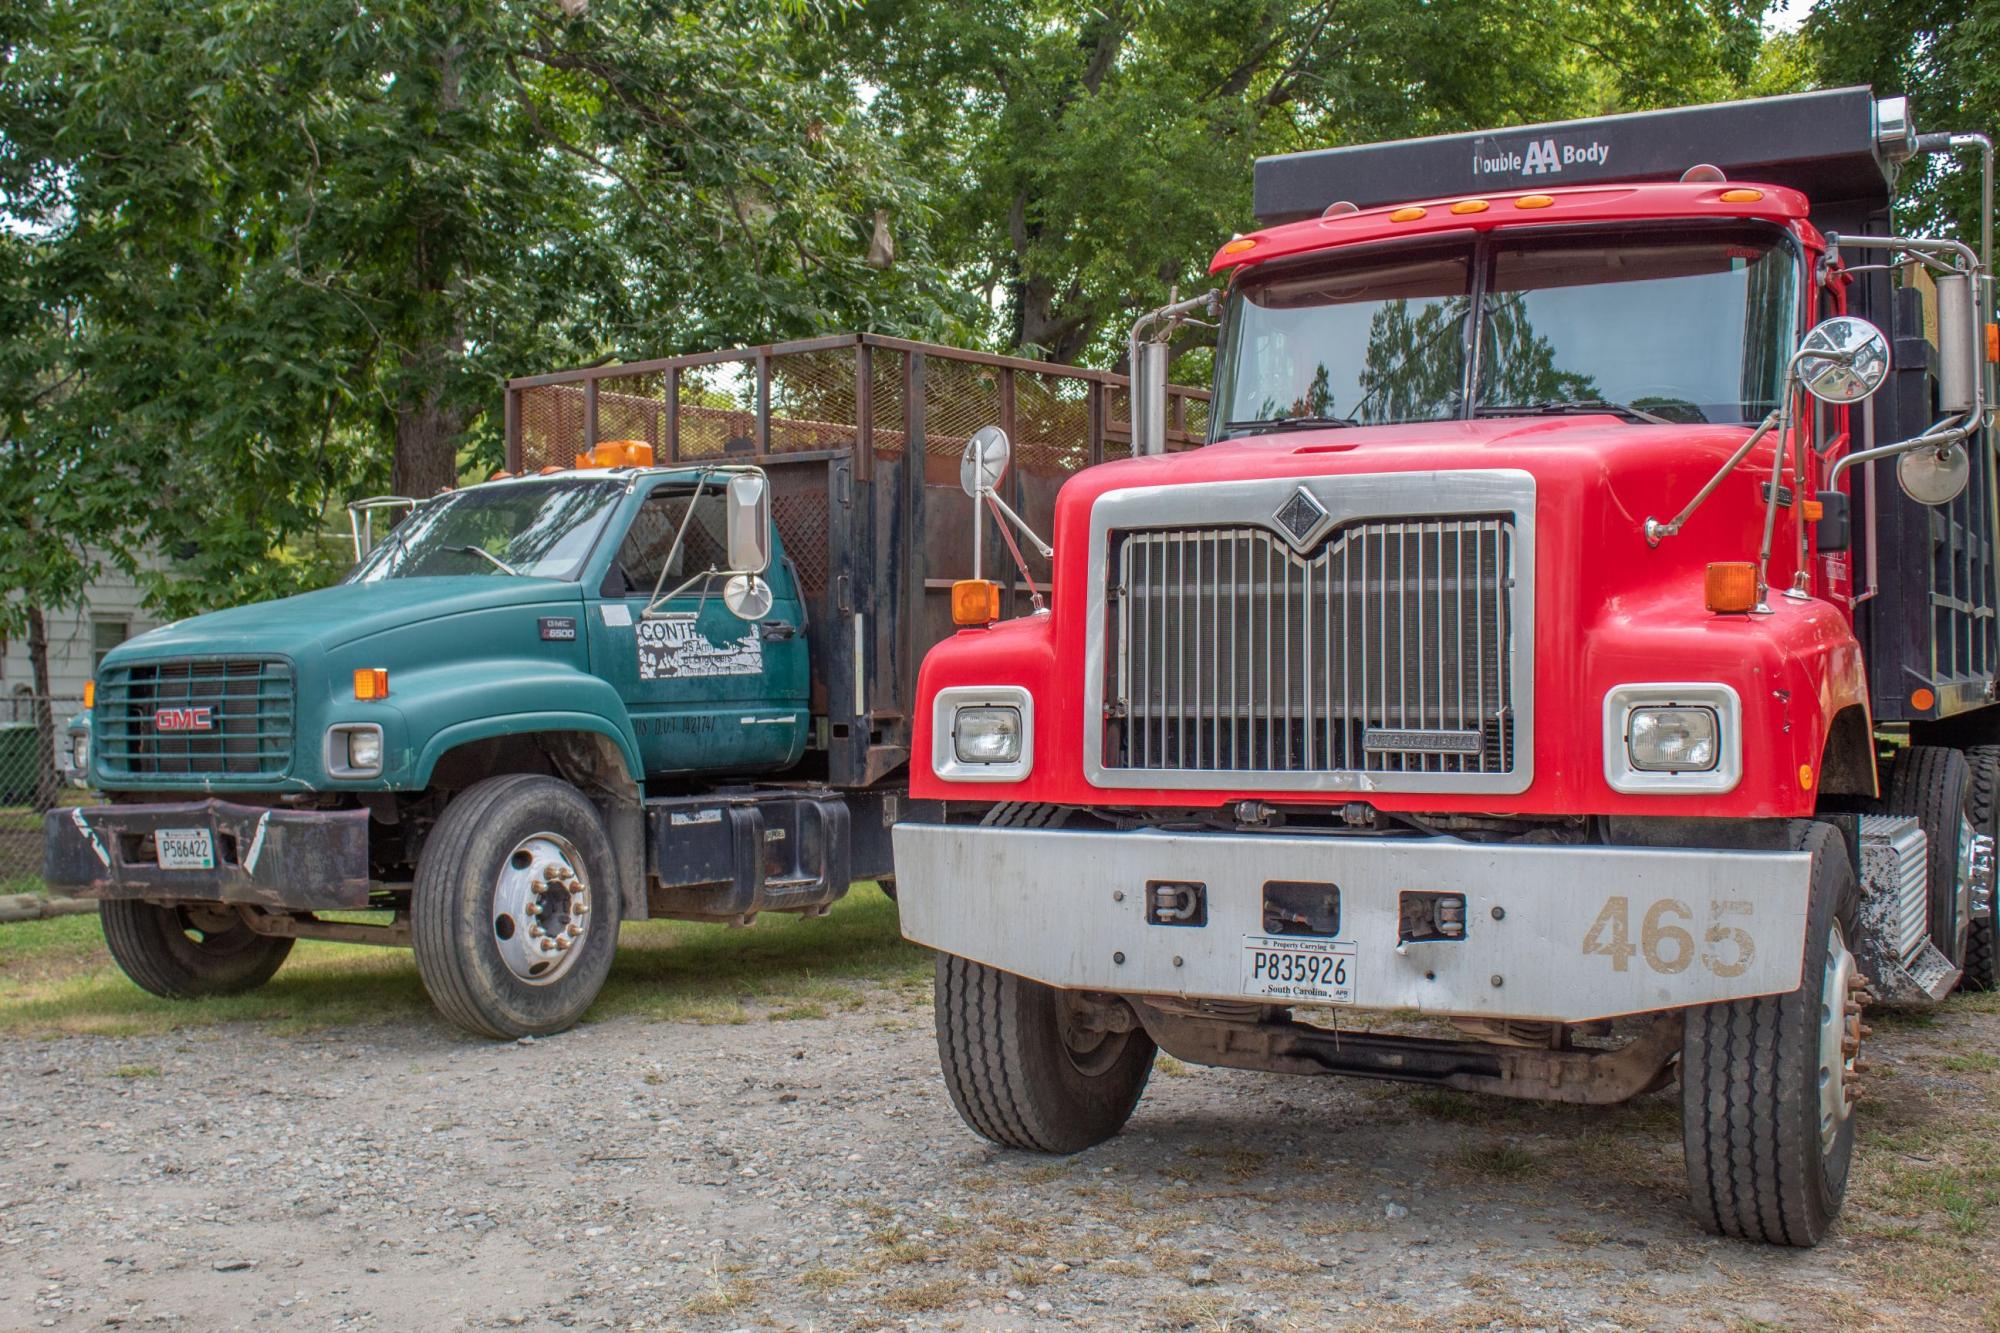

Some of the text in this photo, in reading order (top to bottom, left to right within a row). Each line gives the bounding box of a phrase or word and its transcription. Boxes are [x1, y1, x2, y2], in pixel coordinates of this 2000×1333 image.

[1522, 139, 1562, 176] AA
[1563, 142, 1609, 165] Body
[155, 709, 212, 730] GMC
[163, 840, 208, 858] P586422
[1273, 940, 1327, 951] Property Carrying
[1582, 896, 1756, 978] 465
[1254, 952, 1346, 985] P835926
[1267, 984, 1328, 997] South Carolina
